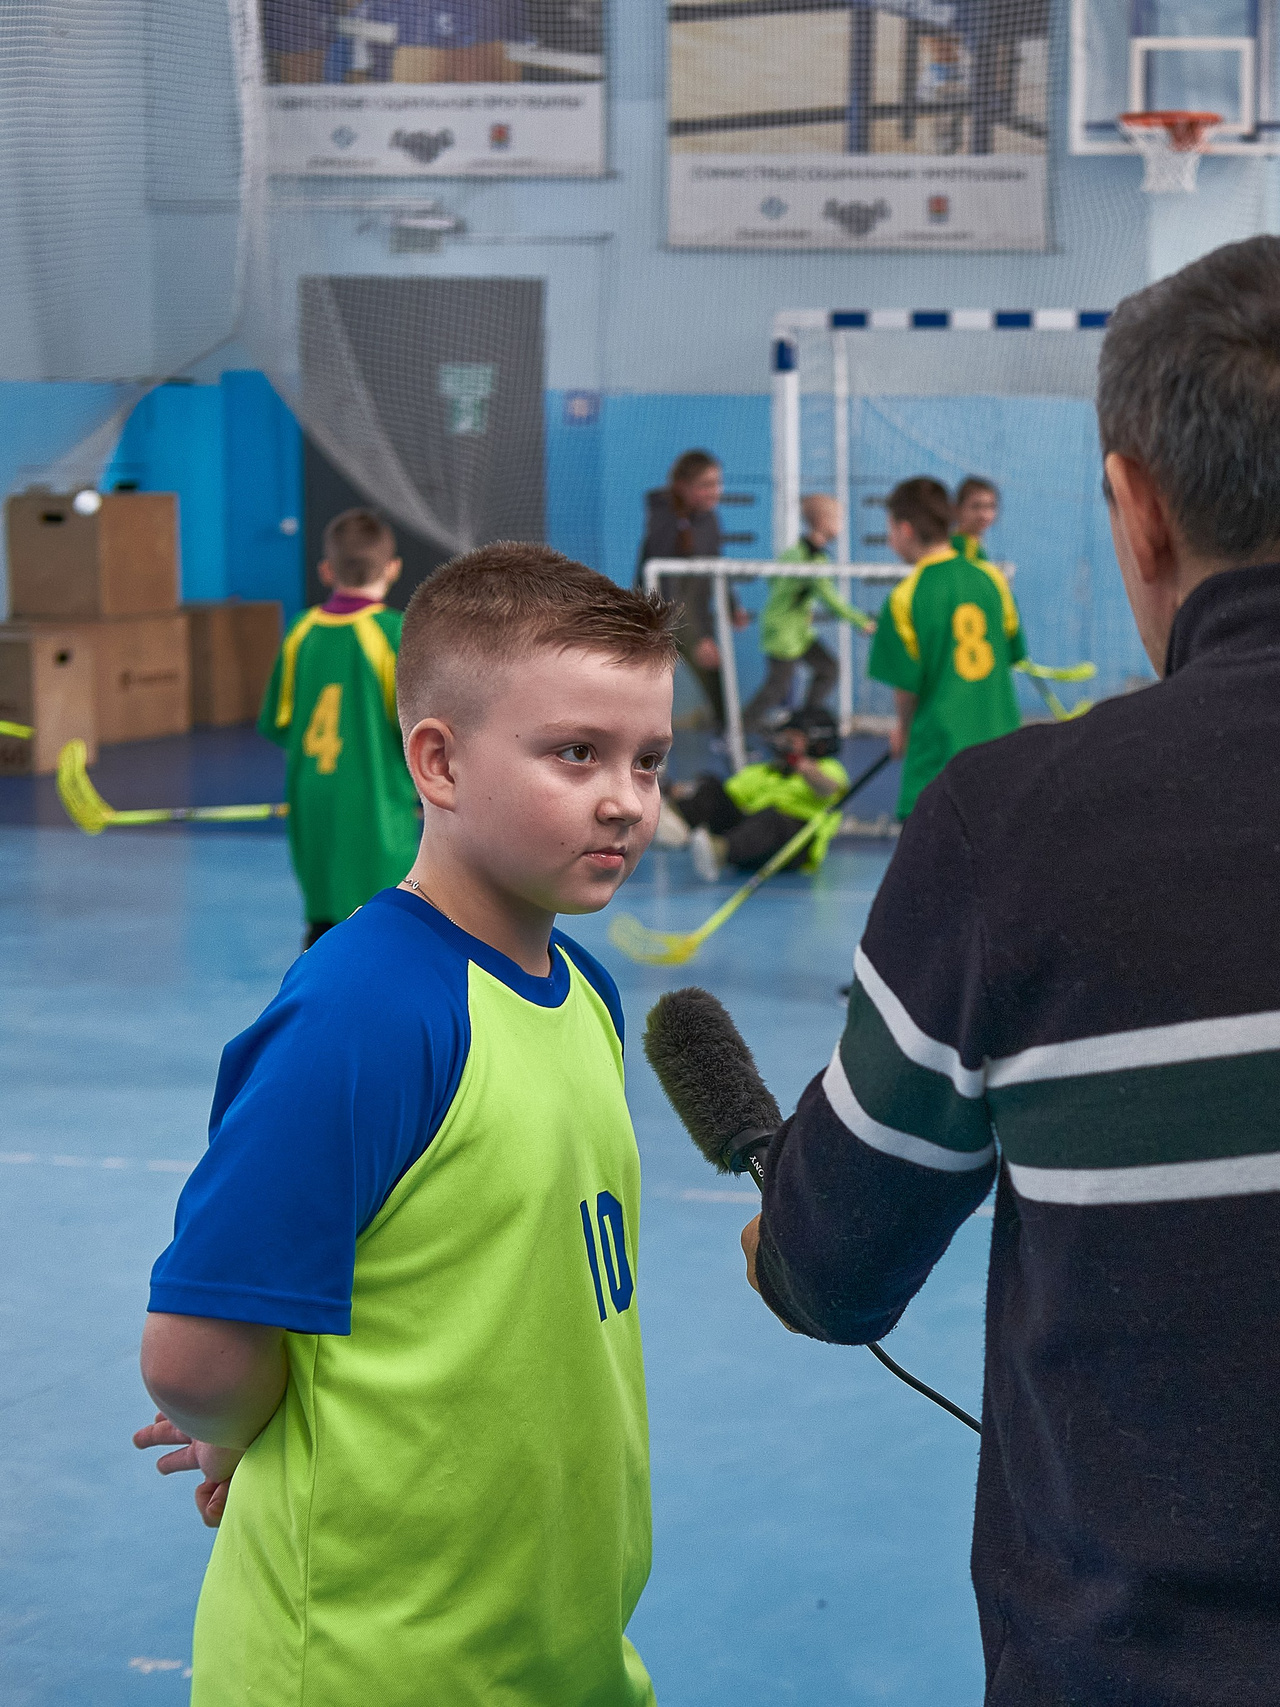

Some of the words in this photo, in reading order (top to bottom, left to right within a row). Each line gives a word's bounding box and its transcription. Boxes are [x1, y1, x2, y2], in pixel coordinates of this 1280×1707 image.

[952, 602, 995, 682] 8
[302, 683, 343, 774] 4
[749, 1155, 765, 1181] ONY
[580, 1190, 634, 1323] 10
